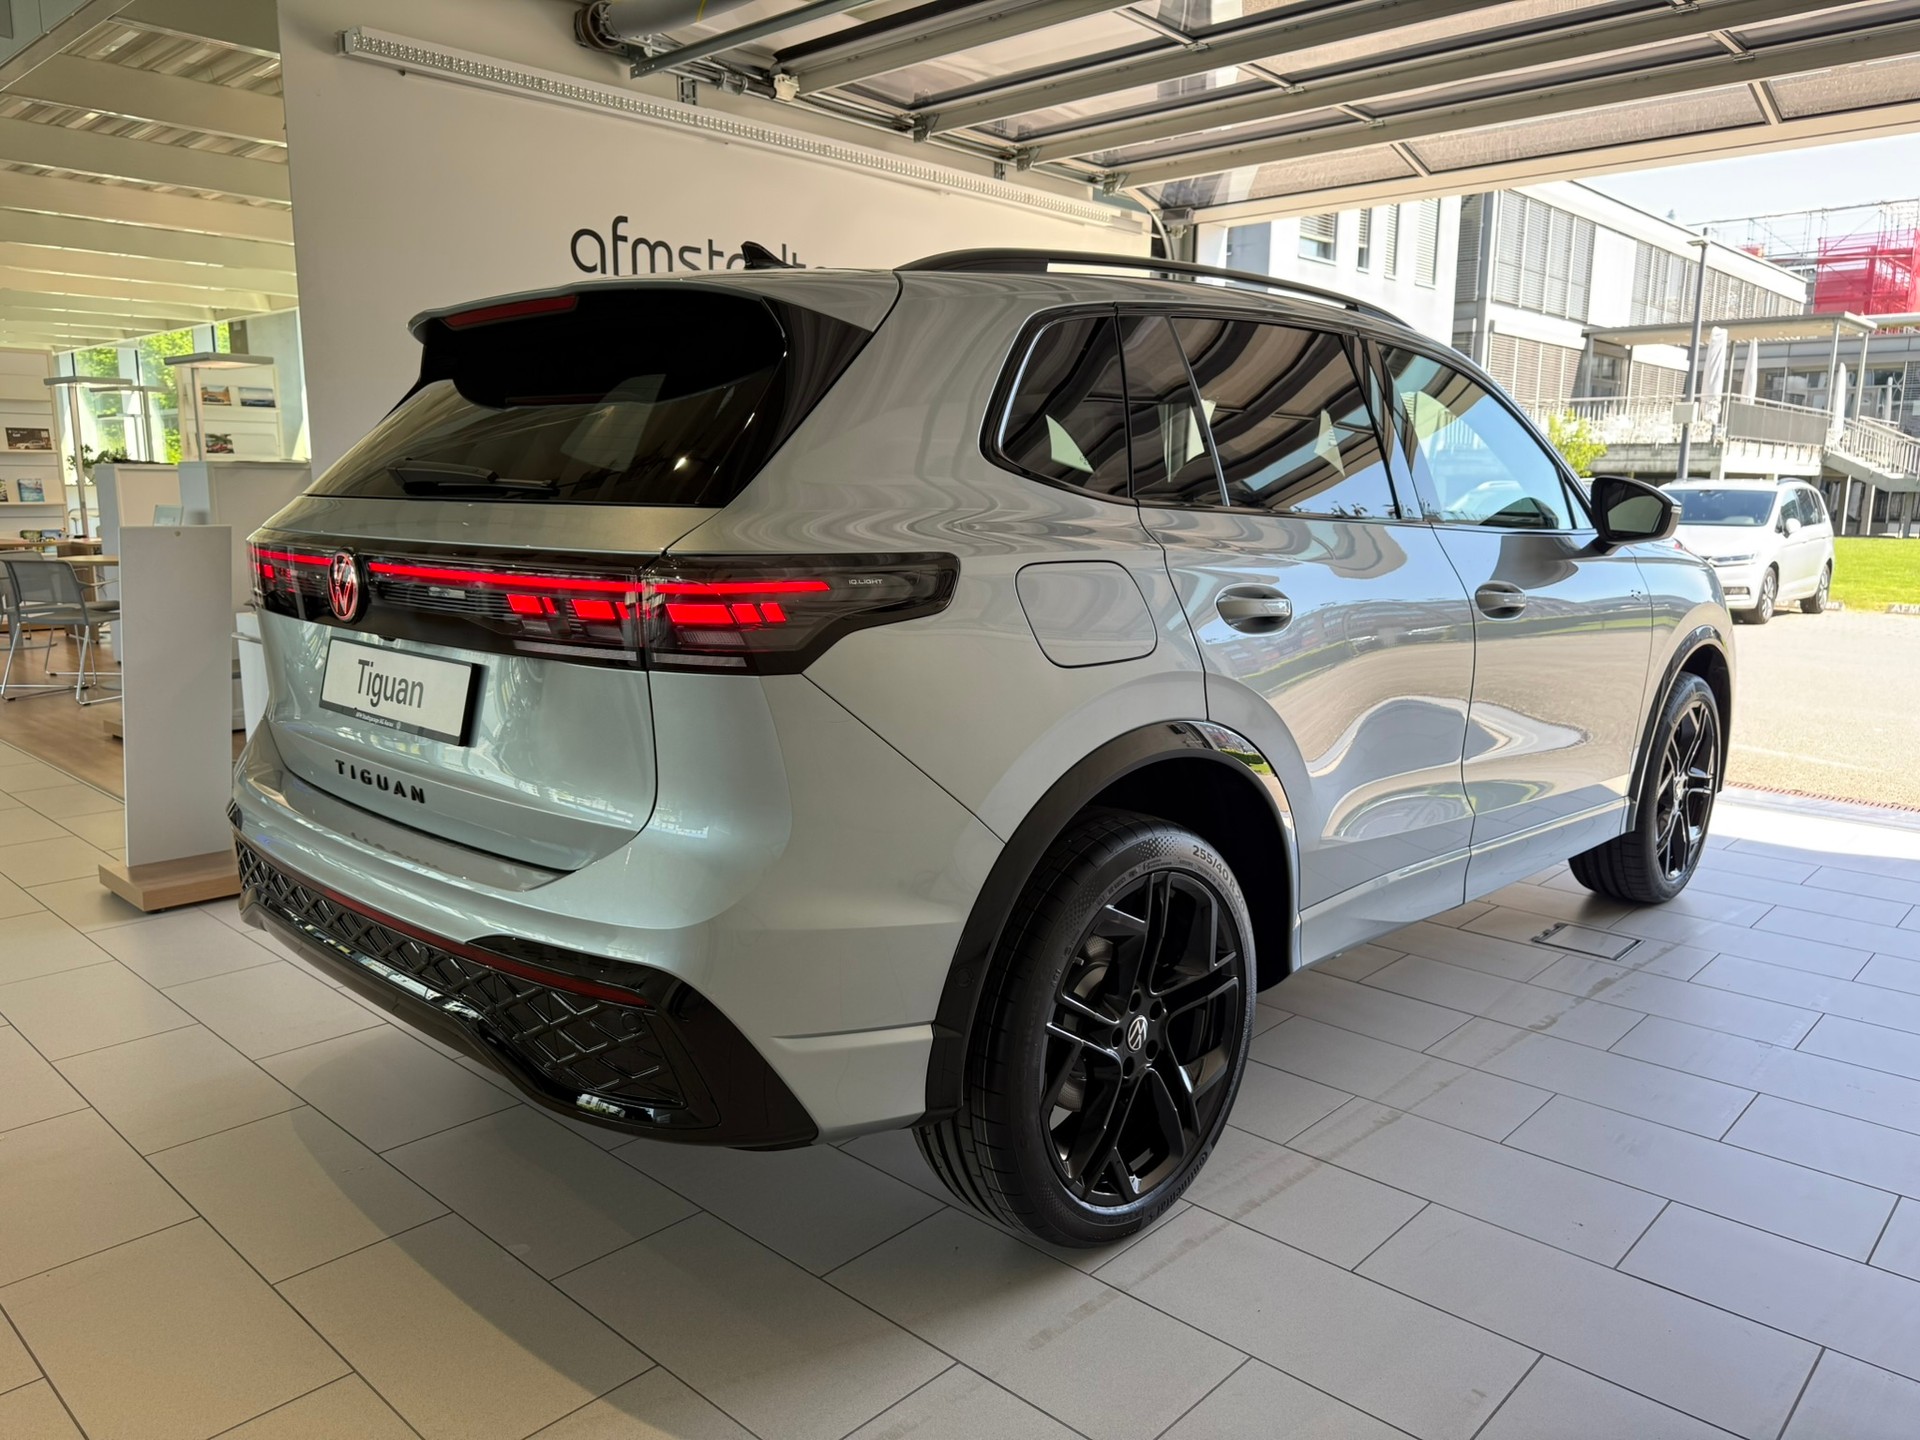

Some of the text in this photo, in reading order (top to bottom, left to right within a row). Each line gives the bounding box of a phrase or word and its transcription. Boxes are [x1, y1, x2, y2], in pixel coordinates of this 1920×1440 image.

[357, 658, 424, 708] Tiguan
[335, 759, 426, 804] TIGUAN
[1192, 844, 1230, 881] 255/40
